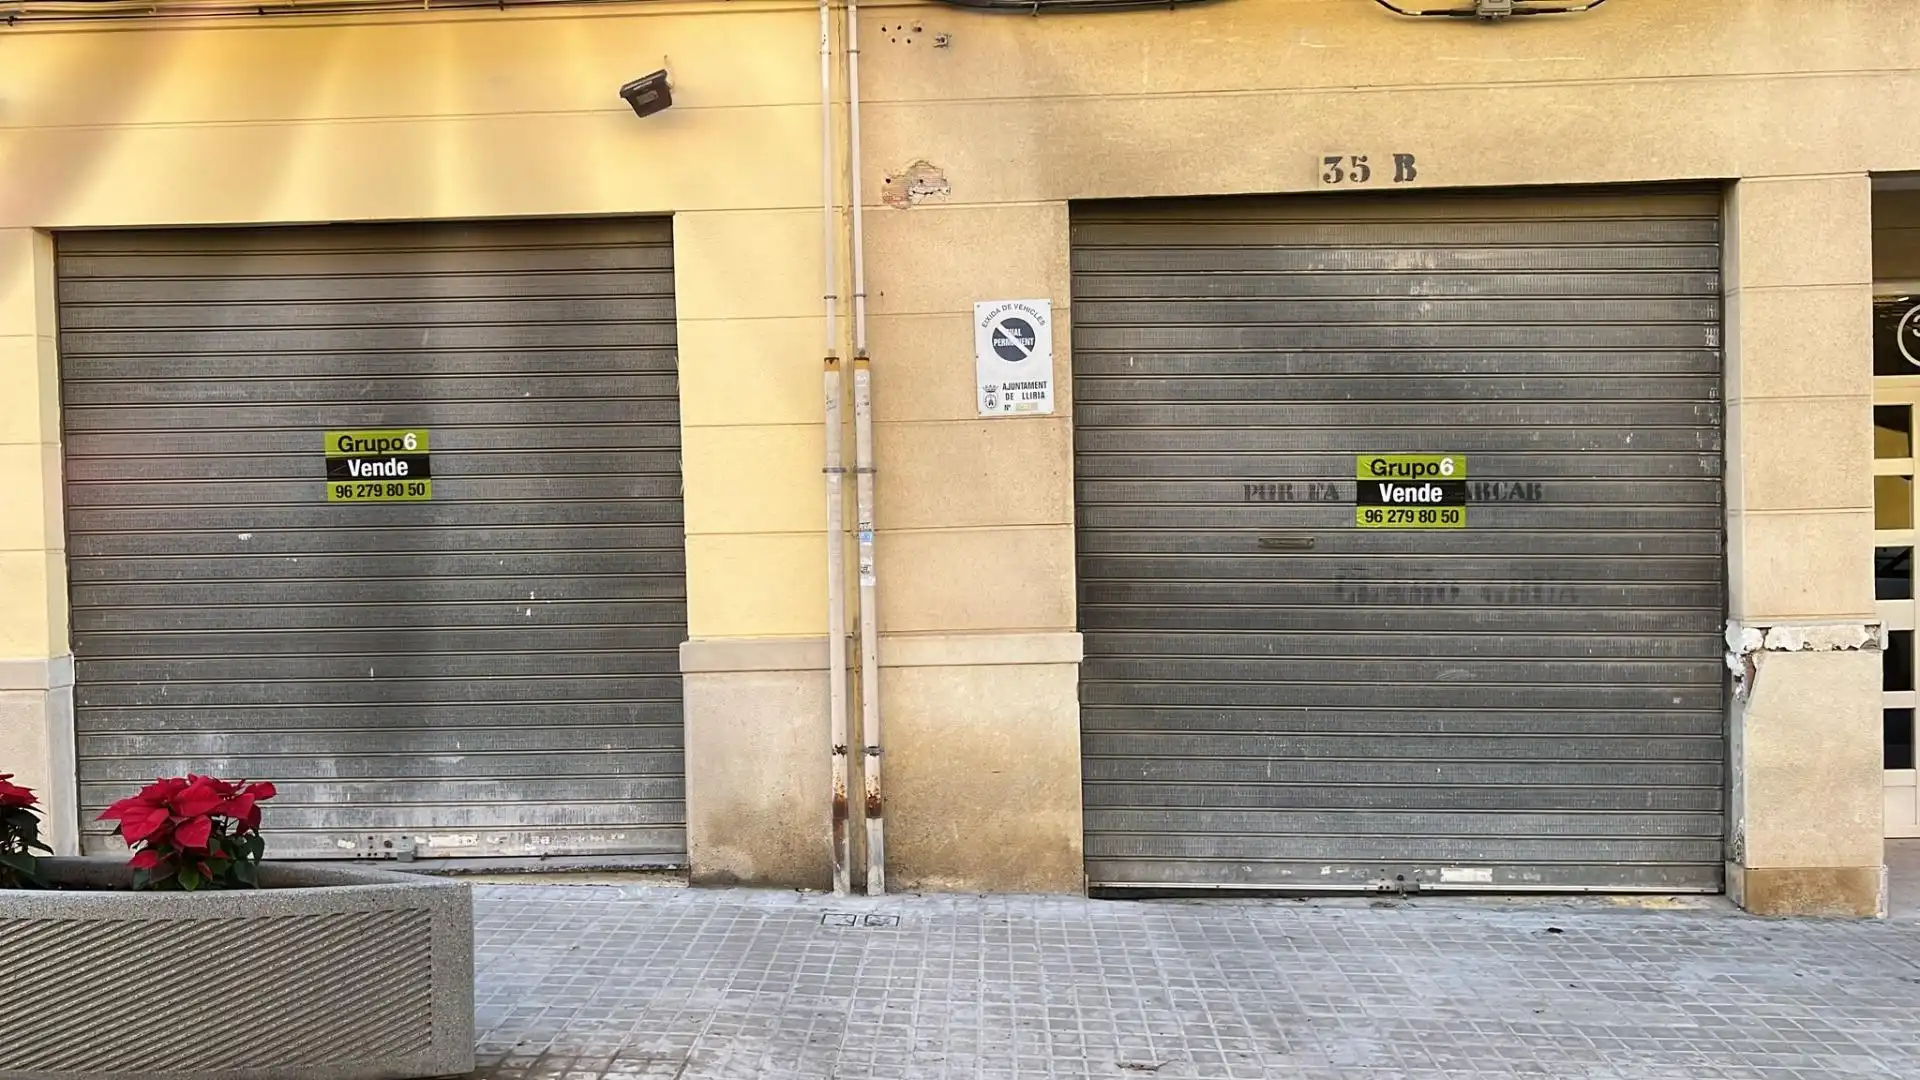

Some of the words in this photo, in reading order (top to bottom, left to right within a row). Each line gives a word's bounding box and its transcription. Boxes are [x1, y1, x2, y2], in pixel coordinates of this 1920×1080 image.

[1323, 155, 1370, 183] 35
[1392, 153, 1417, 182] B
[981, 308, 1001, 328] EIXIDA
[1001, 303, 1012, 311] DE
[1013, 303, 1046, 326] VEHICLES
[1002, 381, 1047, 391] AJUNTAMENT
[1005, 392, 1014, 401] DE
[1022, 391, 1045, 400] LLIRIA
[337, 432, 418, 455] Grupo6
[347, 458, 409, 477] Vende
[1370, 457, 1454, 479] Grupo6
[335, 485, 353, 498] 96
[357, 484, 382, 498] 279
[386, 483, 404, 497] 80
[408, 483, 425, 496] 50
[1379, 483, 1443, 502] Vende
[1365, 510, 1383, 523] 96
[1387, 510, 1414, 523] 279
[1418, 510, 1437, 523] 80
[1441, 509, 1459, 523] 50
